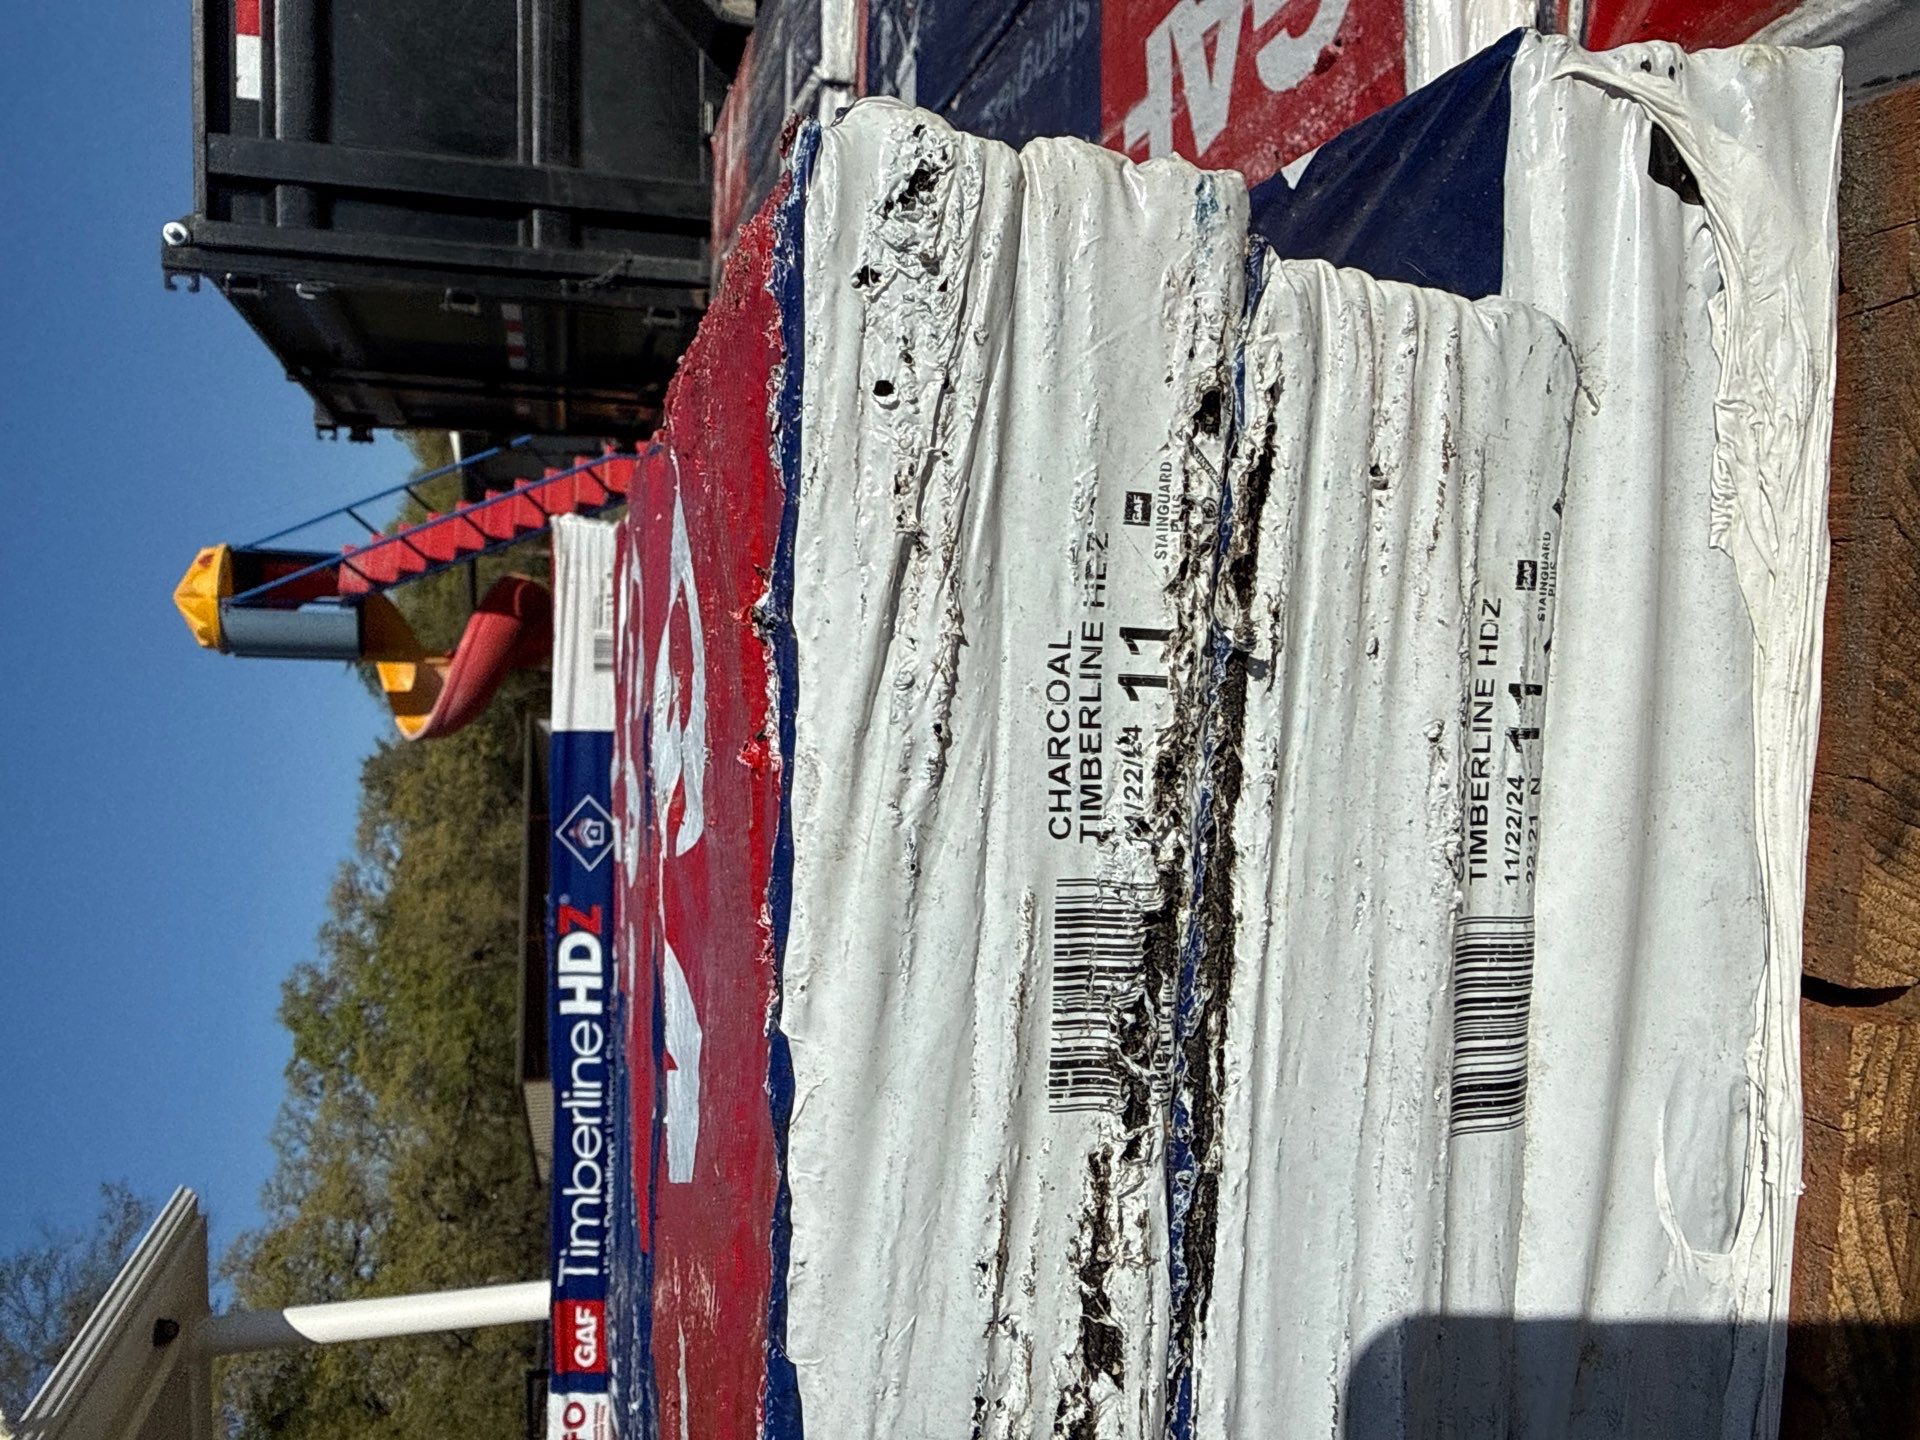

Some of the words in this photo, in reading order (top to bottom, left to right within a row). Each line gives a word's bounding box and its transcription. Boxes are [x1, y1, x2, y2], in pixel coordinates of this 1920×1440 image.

[1154, 461, 1172, 560] STAINGUARD
[1537, 531, 1552, 622] STAINGUARD
[1117, 625, 1172, 702] 11
[1477, 598, 1501, 666] HDZ
[1046, 630, 1072, 840] CHARCOAL
[1078, 622, 1104, 843] TIMBERLINE
[1505, 683, 1543, 753] 11
[1469, 678, 1494, 886] TIMBERLINE
[1504, 775, 1525, 885] 11/22/24
[573, 1305, 598, 1368] GAF
